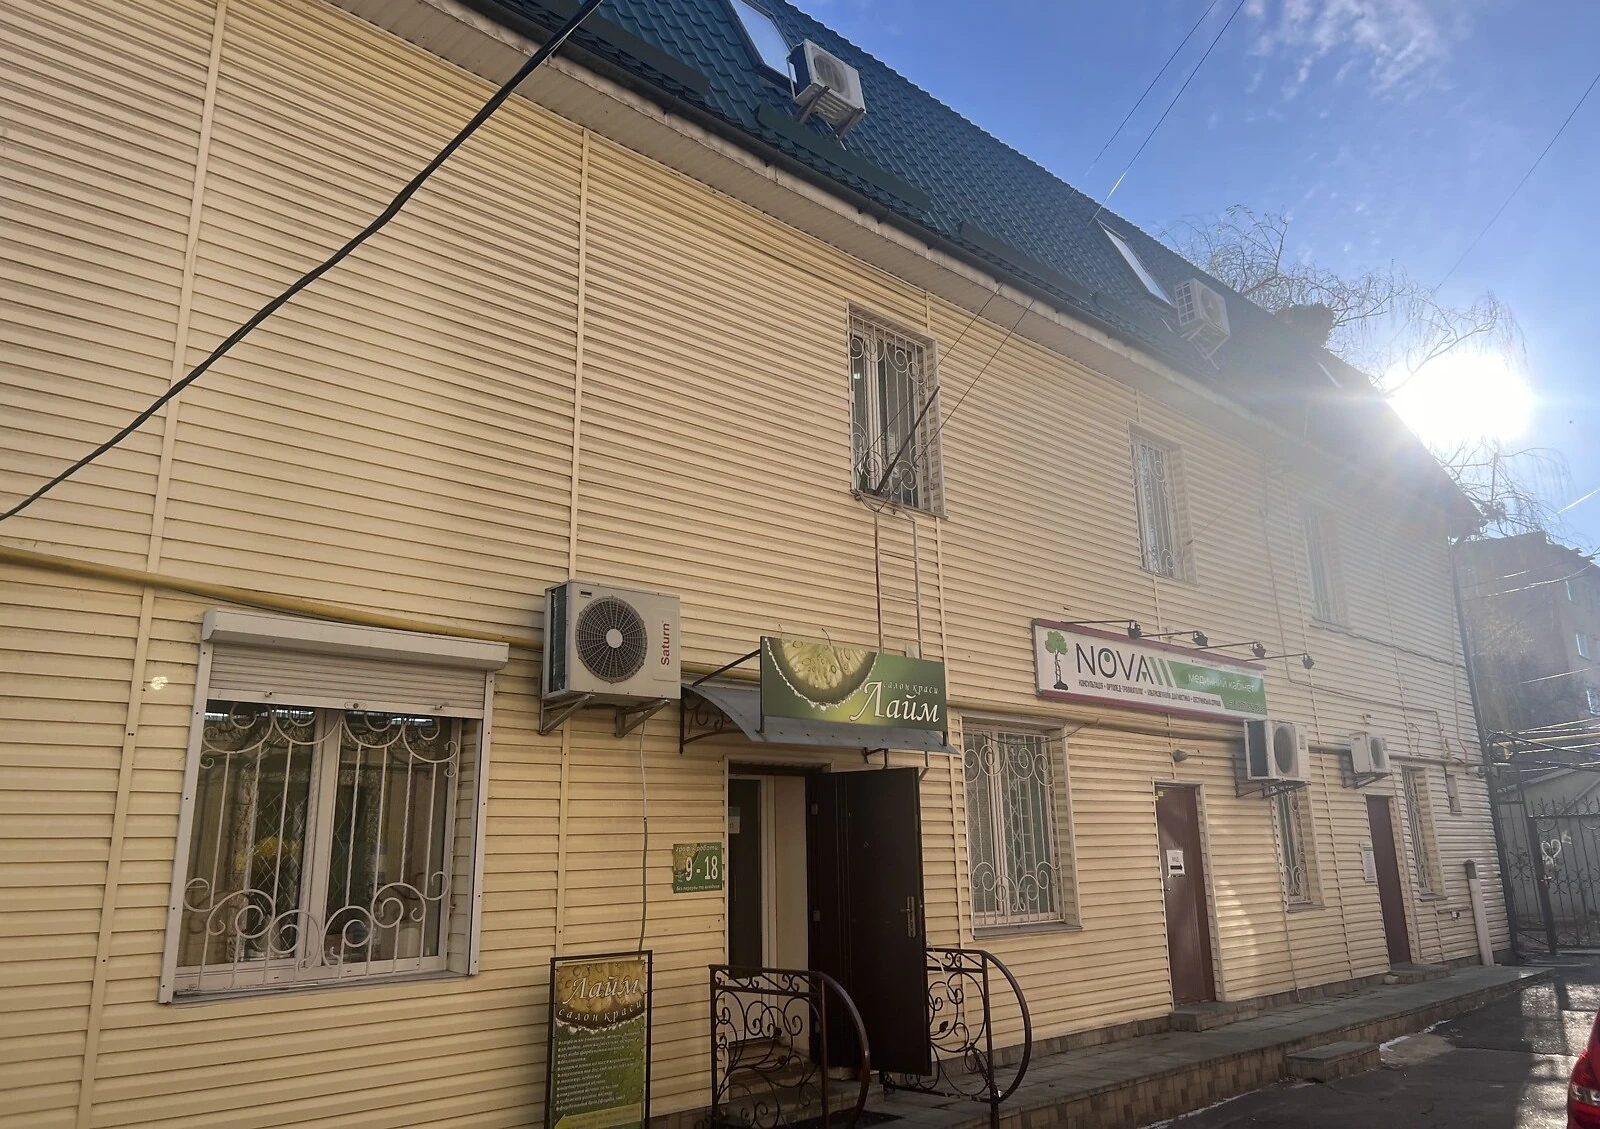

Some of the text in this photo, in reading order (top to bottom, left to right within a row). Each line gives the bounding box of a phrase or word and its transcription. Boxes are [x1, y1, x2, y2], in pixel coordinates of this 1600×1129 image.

[661, 623, 670, 665] Saturn
[1076, 643, 1154, 684] NOVA
[849, 681, 940, 723] Лайм
[685, 856, 693, 881] 9
[704, 855, 718, 880] 18
[562, 976, 639, 1005] Лайм
[558, 1000, 641, 1022] салон краси
